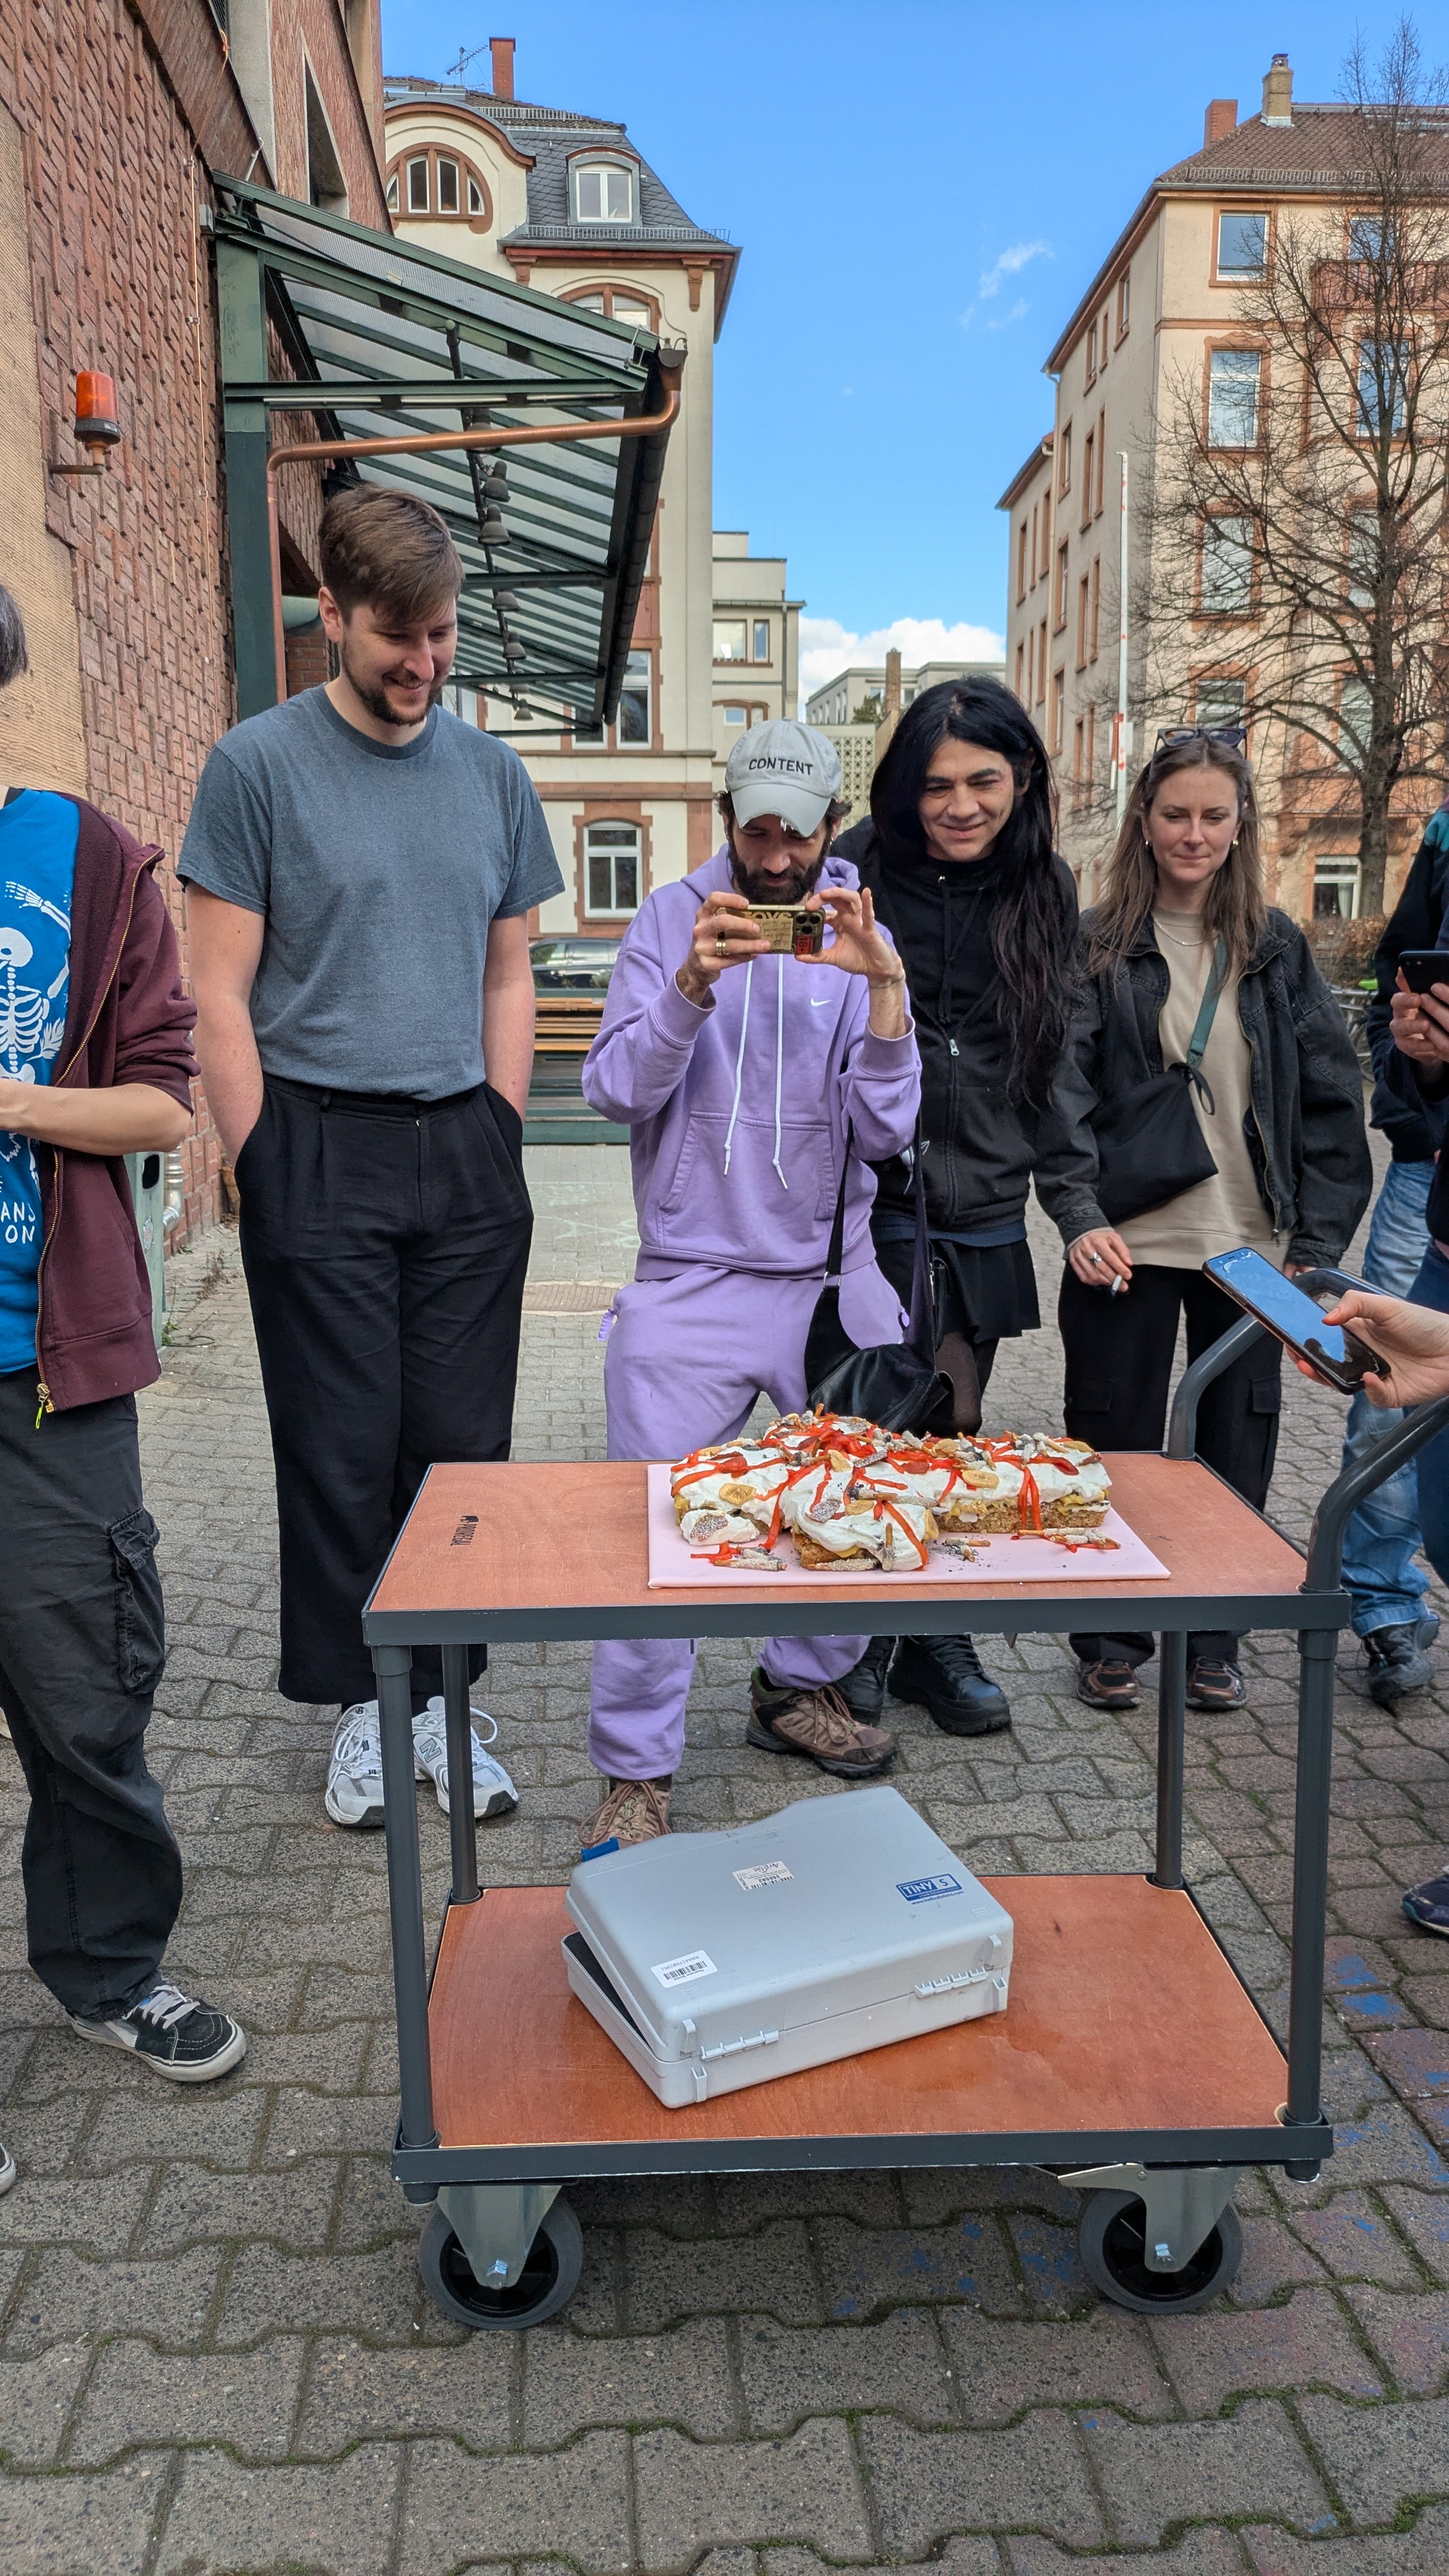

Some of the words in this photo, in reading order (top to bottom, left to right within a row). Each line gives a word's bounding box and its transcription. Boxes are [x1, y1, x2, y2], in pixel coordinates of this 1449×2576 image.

[749, 757, 813, 776] CONTENT
[903, 1882, 932, 1894] TINY
[939, 1878, 948, 1887] S
